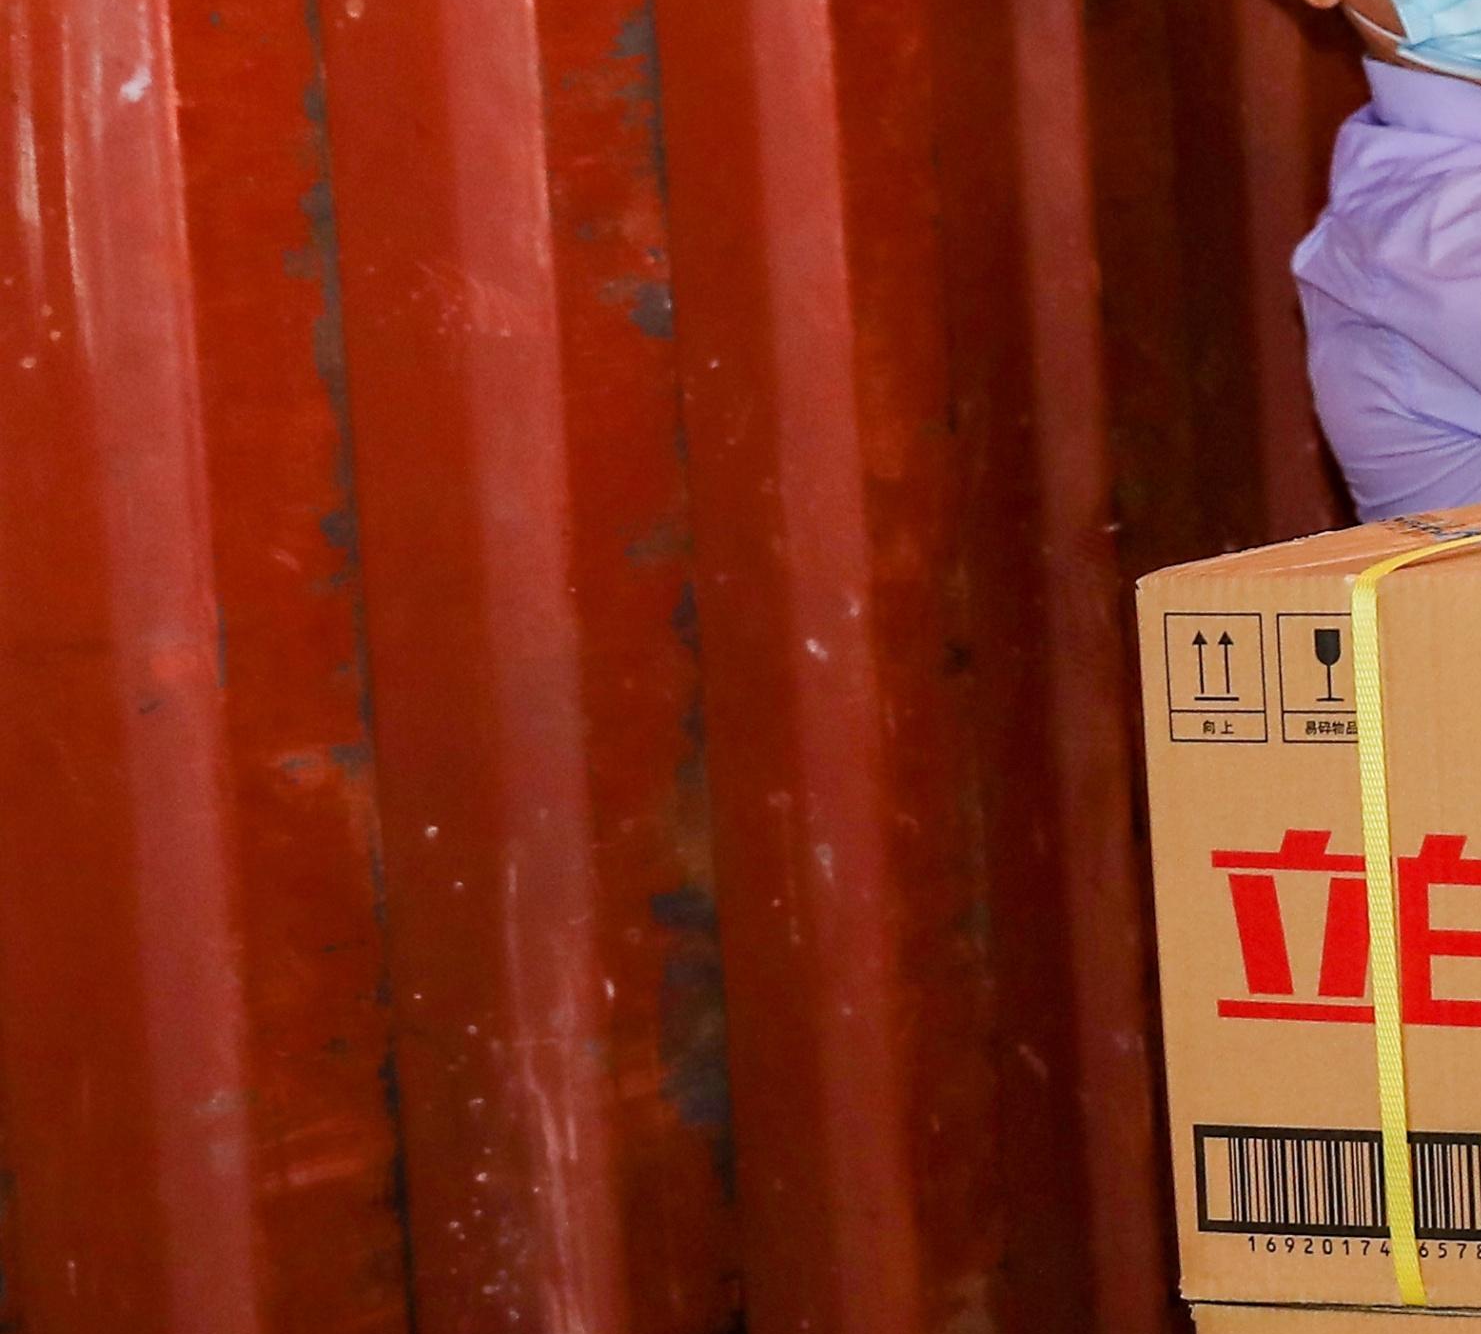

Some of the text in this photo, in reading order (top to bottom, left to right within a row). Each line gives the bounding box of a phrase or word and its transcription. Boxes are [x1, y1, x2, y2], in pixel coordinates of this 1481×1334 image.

[1203, 720, 1233, 734] 向上
[1306, 721, 1358, 734] 易碎物品
